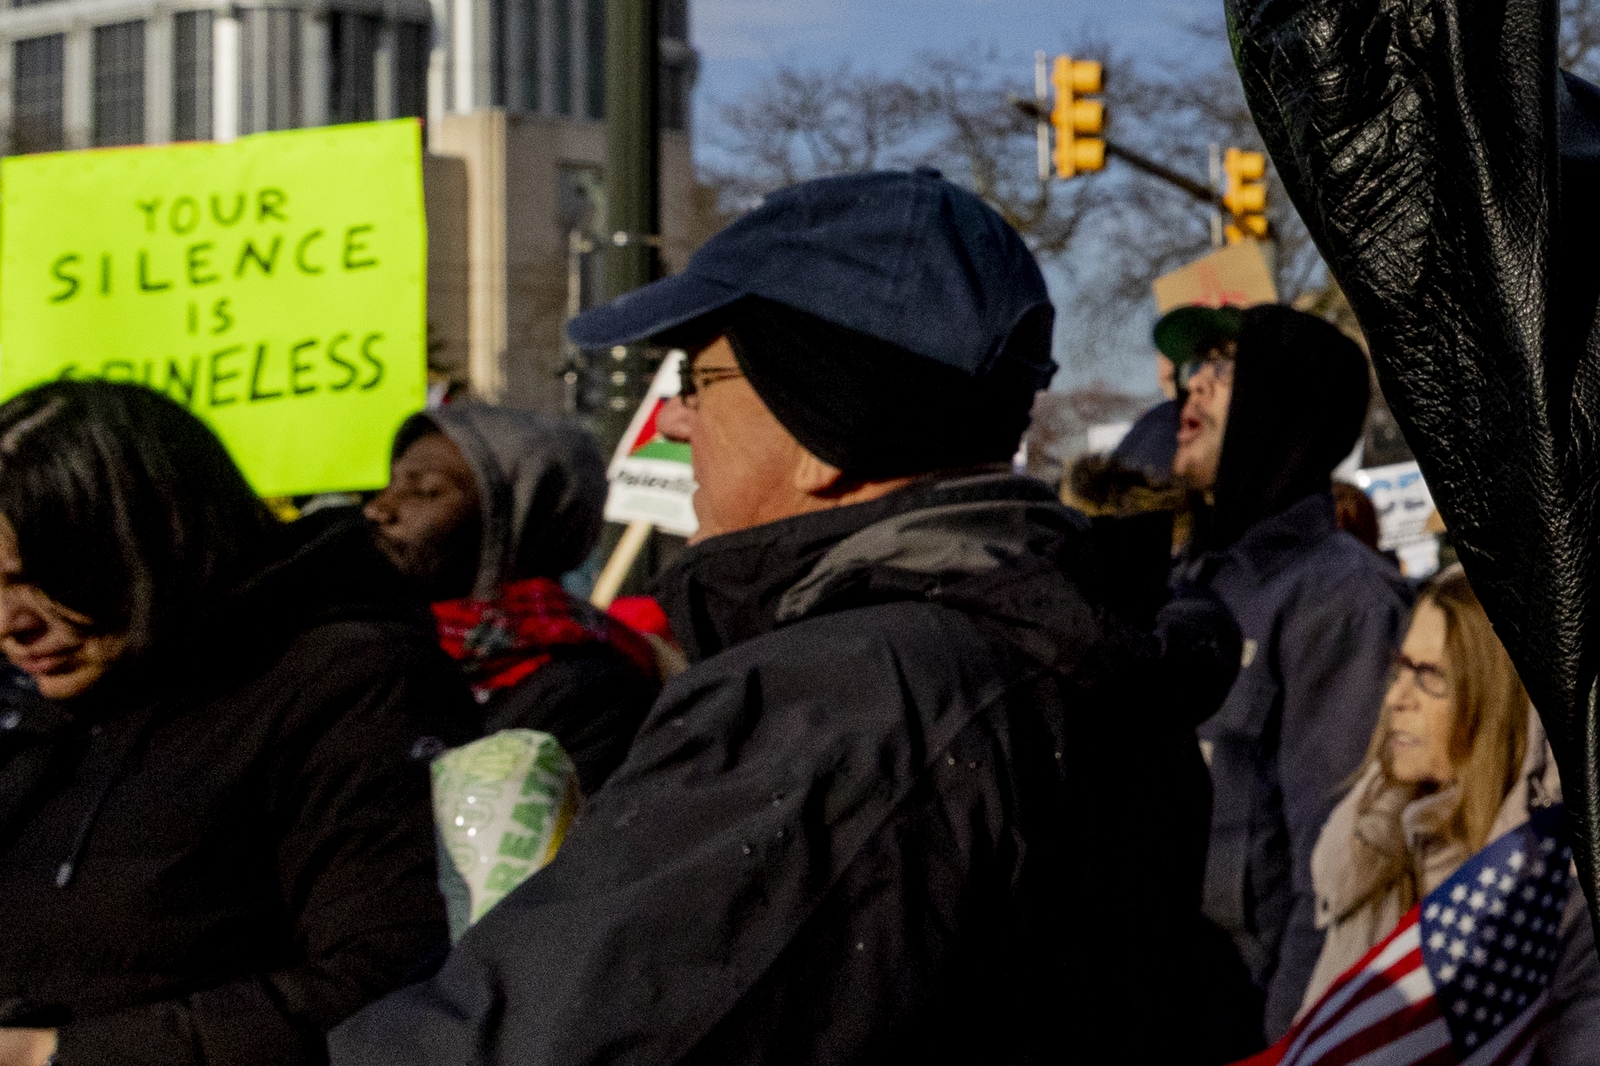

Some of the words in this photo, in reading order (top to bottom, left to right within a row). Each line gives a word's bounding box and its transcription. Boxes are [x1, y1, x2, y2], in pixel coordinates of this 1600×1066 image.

[135, 188, 288, 235] YOUR
[48, 225, 379, 303] SILENCE
[188, 298, 234, 335] IS
